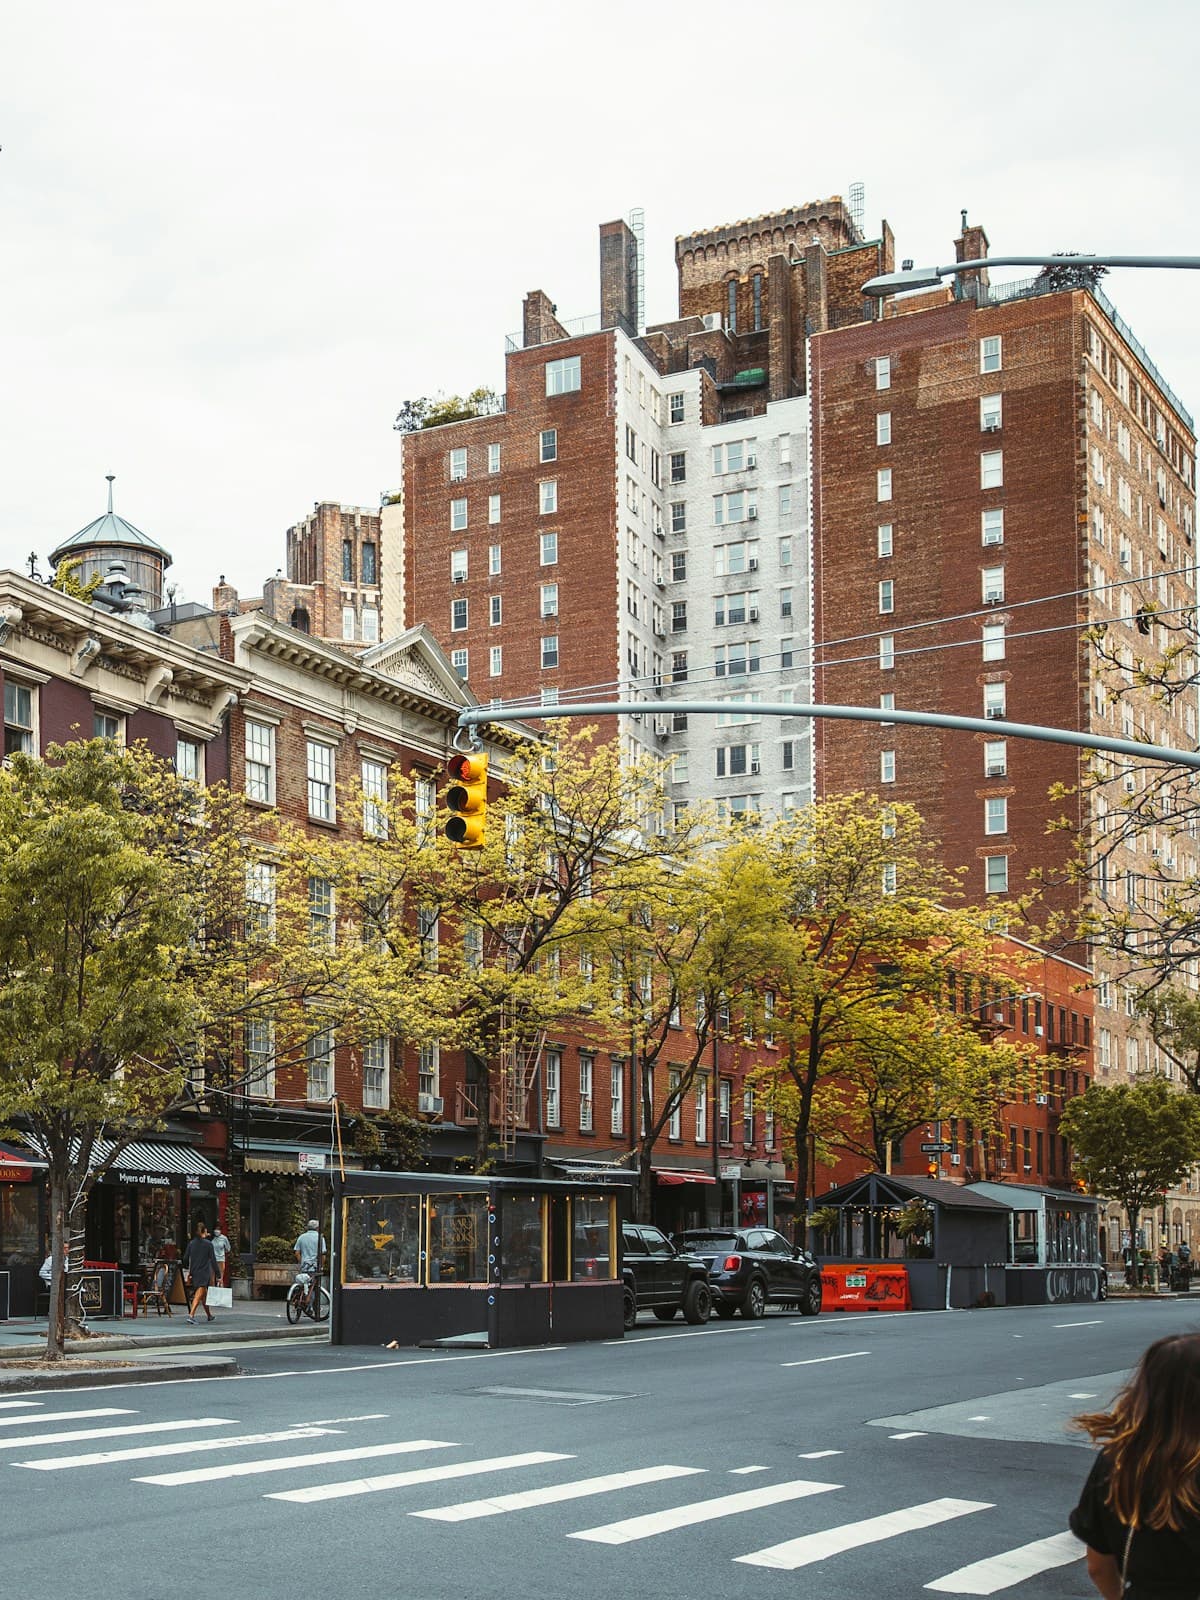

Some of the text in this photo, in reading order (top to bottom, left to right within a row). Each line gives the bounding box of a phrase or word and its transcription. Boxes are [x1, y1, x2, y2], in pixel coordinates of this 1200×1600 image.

[119, 1173, 170, 1185] Myers of Keswick
